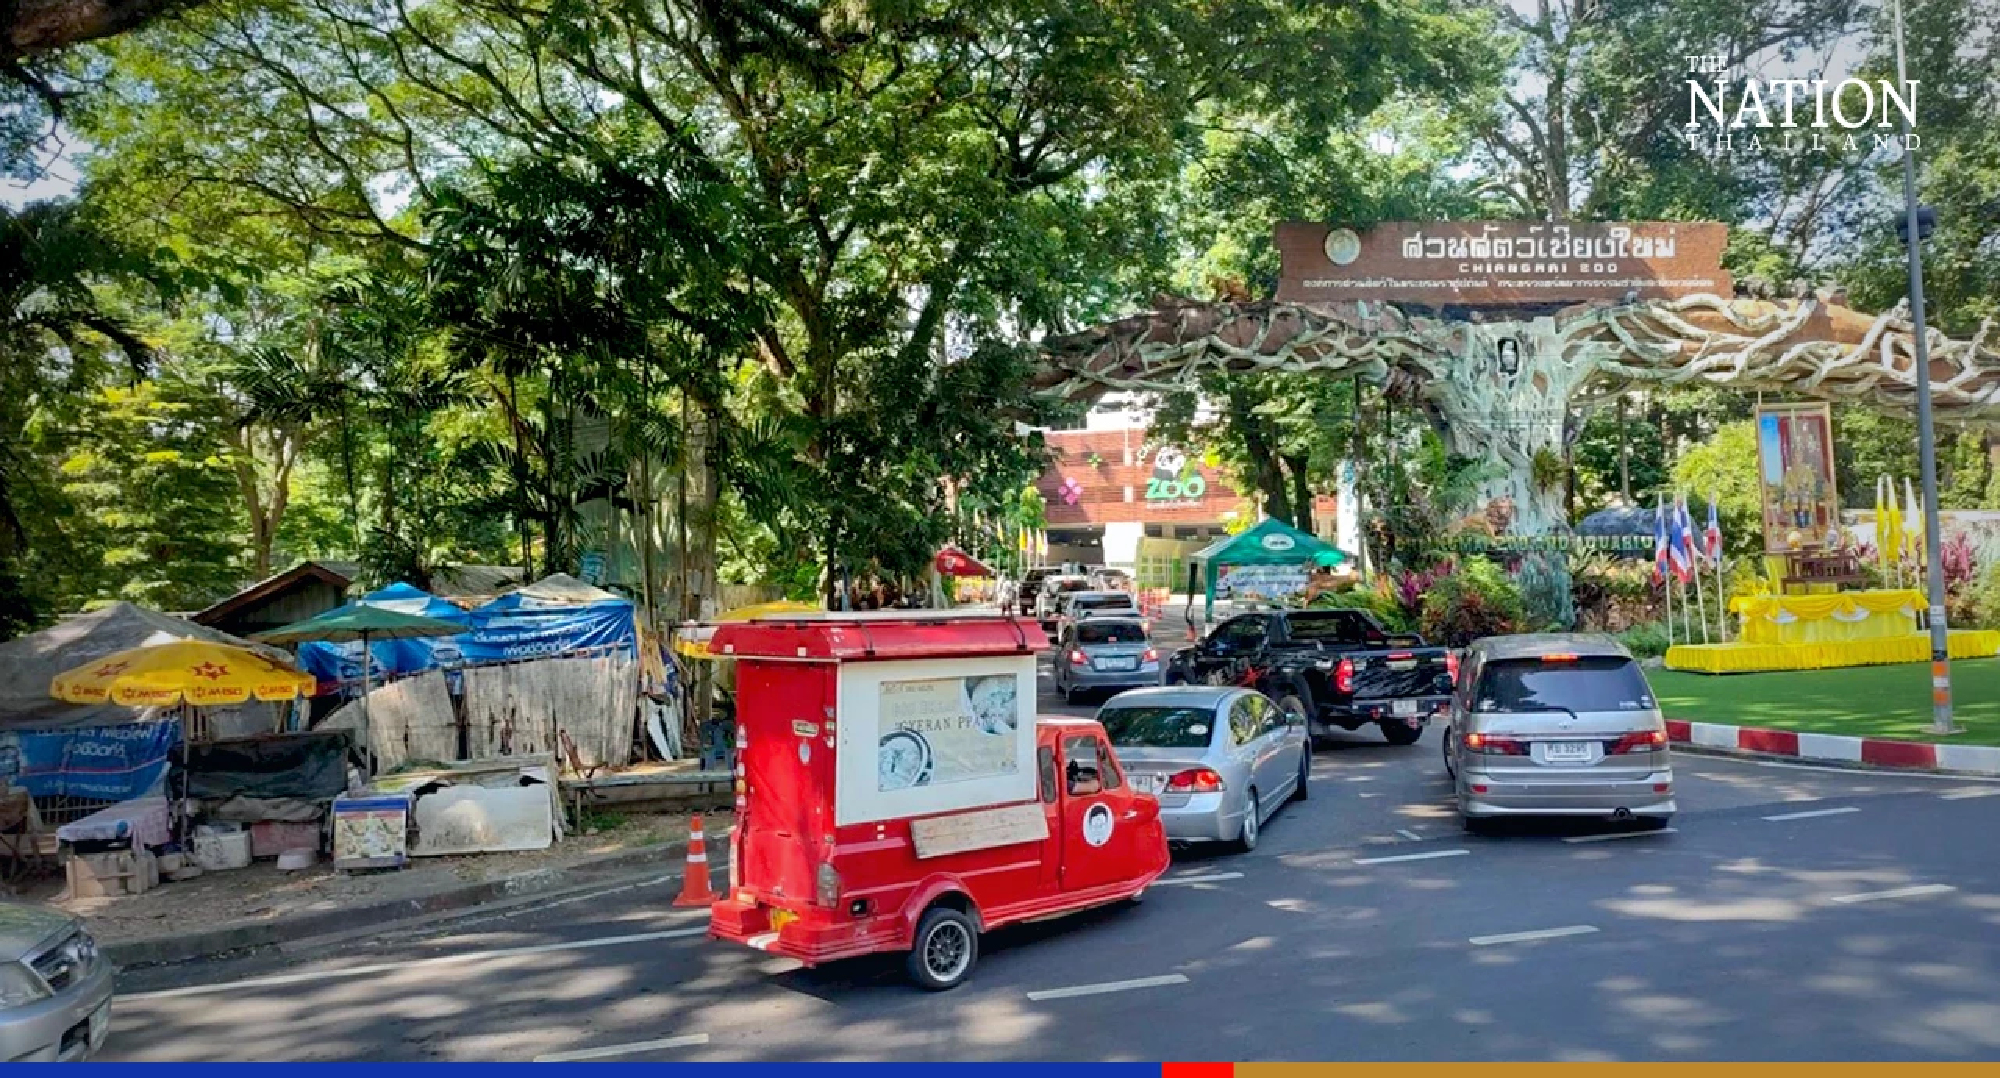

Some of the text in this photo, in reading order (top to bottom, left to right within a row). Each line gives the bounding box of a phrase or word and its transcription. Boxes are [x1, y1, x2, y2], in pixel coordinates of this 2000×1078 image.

[1402, 224, 1676, 259] สวนสัตว์เชียงใหม่
[1458, 262, 1619, 274] CHIANGMAI ZOO
[1576, 535, 1656, 550] AQUARIU
